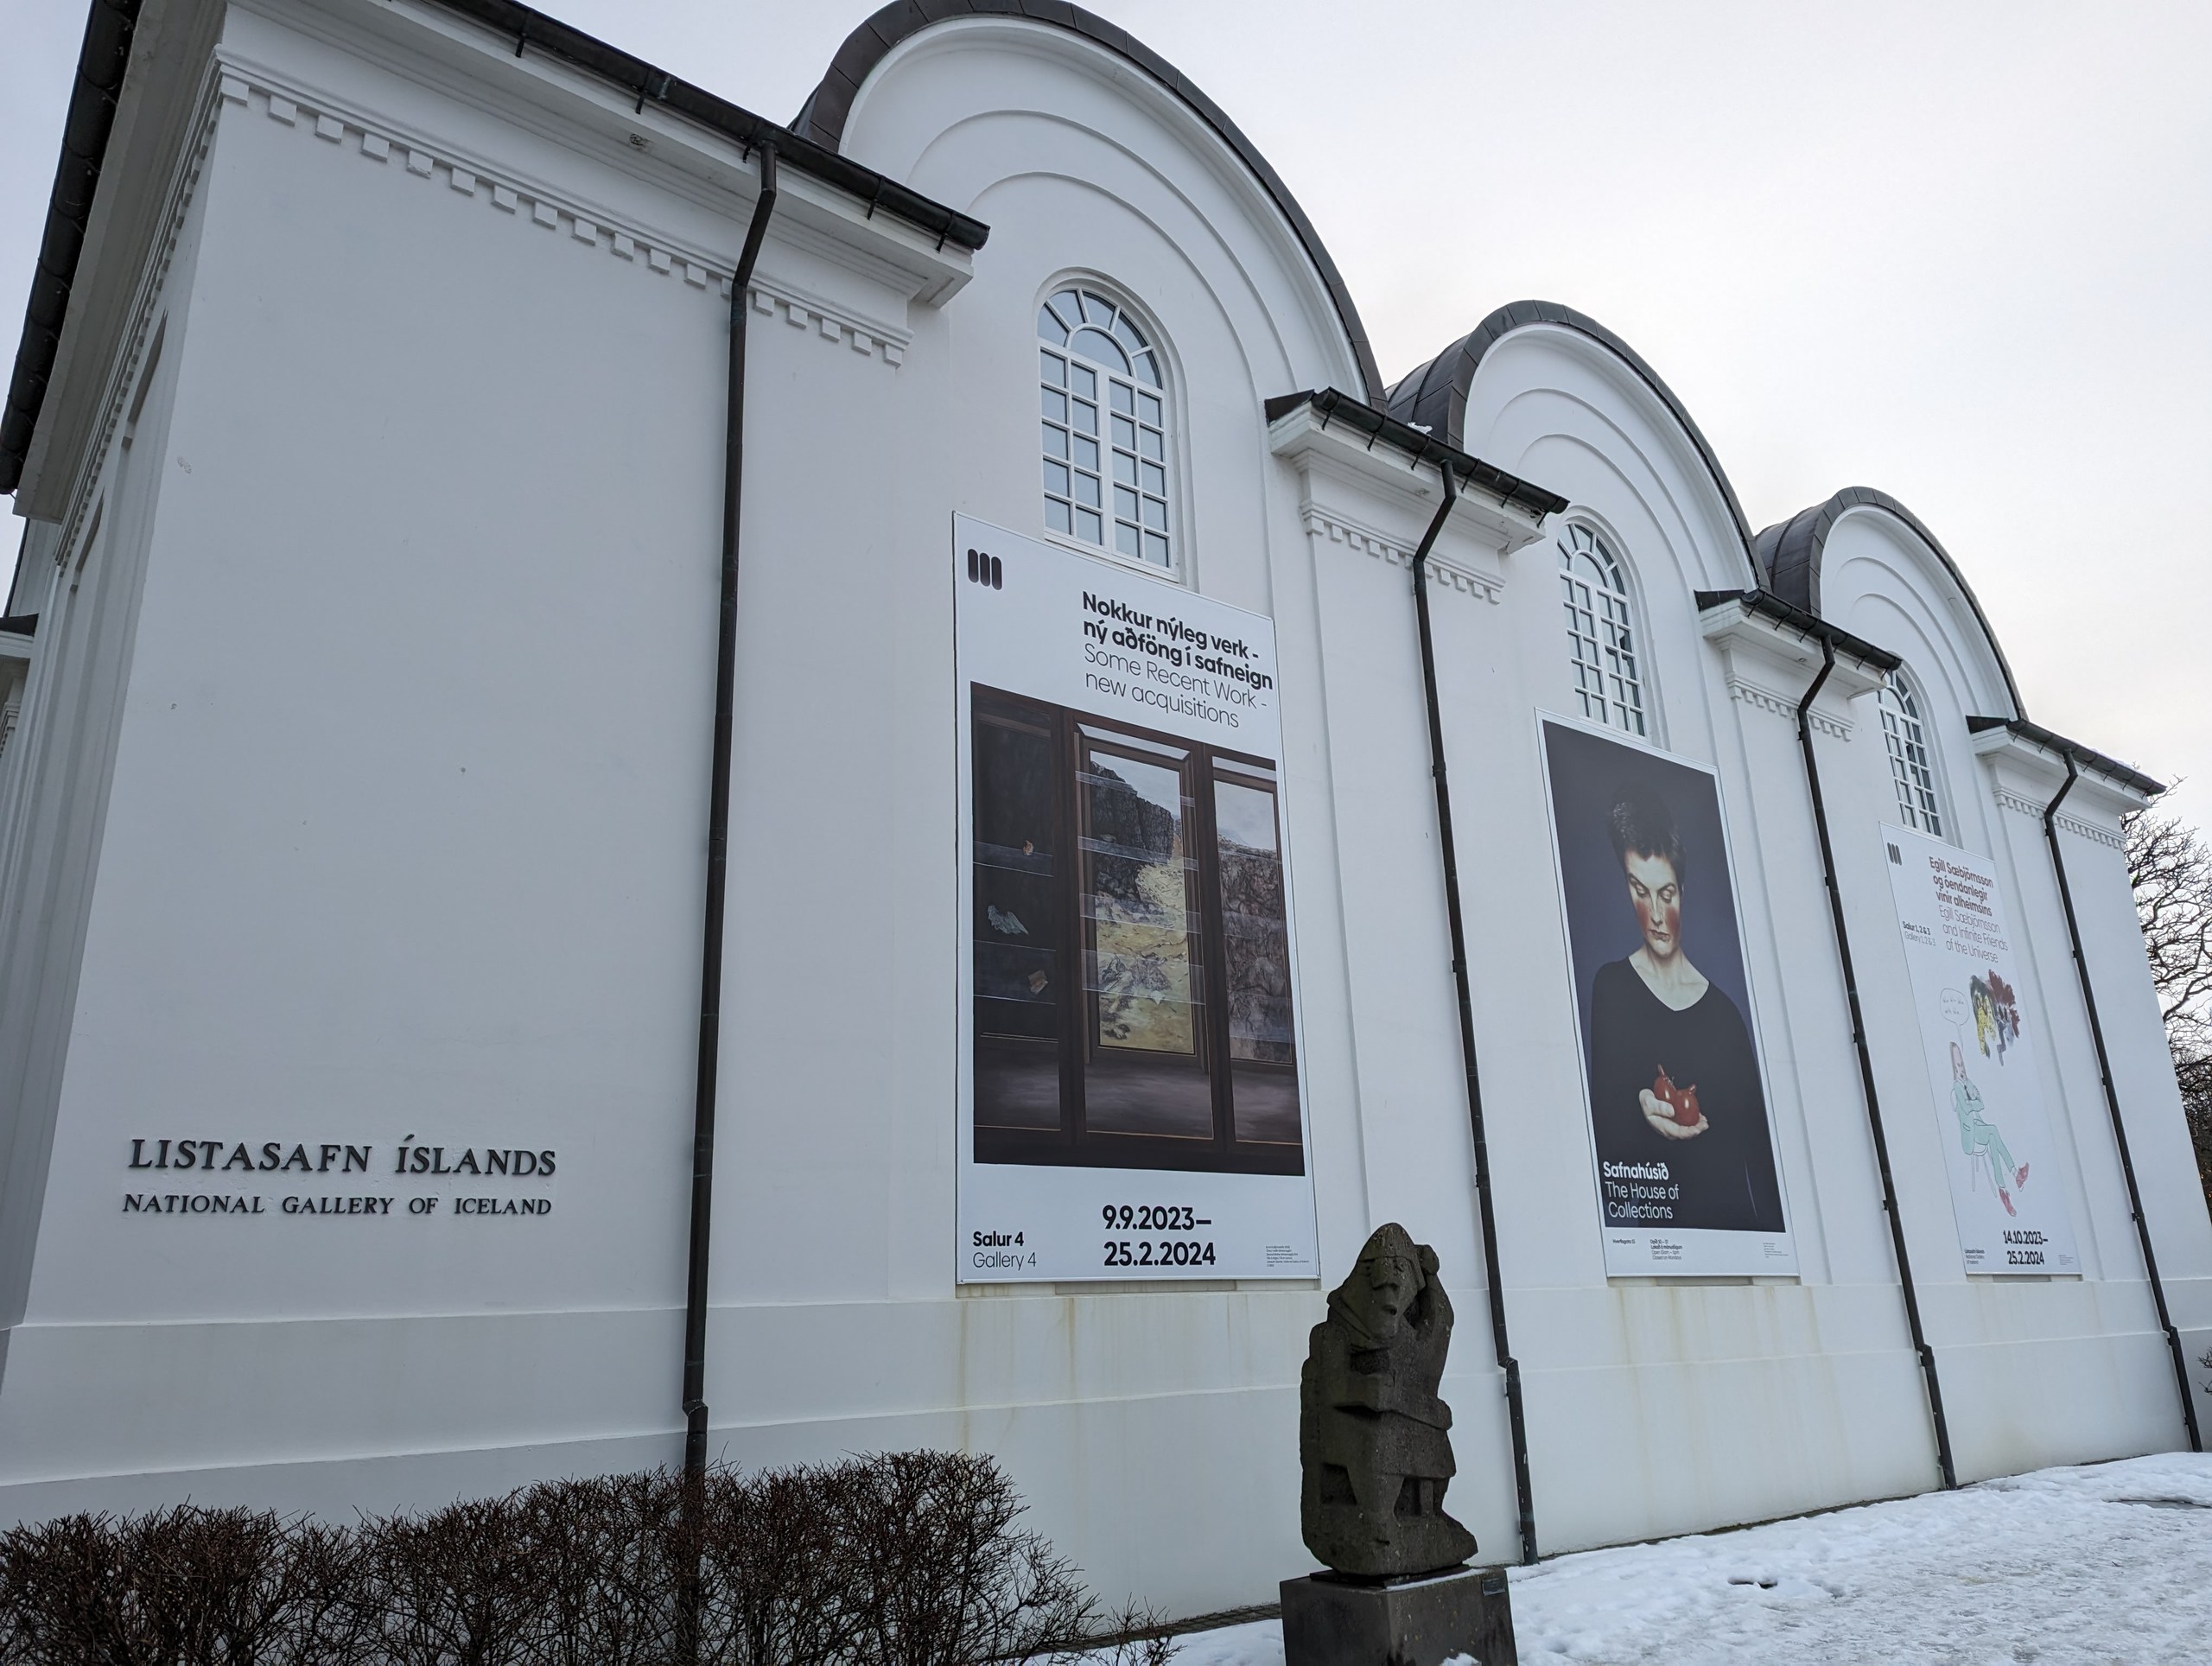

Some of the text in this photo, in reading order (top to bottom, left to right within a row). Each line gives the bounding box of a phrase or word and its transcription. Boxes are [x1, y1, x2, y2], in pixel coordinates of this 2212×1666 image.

[1082, 590, 1153, 630] Nokkur
[1156, 617, 1207, 650] nýleg
[1211, 635, 1249, 659] verk
[1083, 618, 1274, 691] ný aðföng í safneign
[1084, 643, 1141, 676] Some
[1147, 663, 1211, 696] Recent
[1213, 679, 1257, 709] Work
[1085, 671, 1240, 728] new acquisitions
[1929, 855, 1946, 874] Egill
[1933, 874, 1943, 889] og
[1936, 888, 1953, 905] vinir
[1942, 924, 1958, 937] and
[1982, 932, 2008, 951] Friends
[1946, 938, 1999, 963] of the Universe
[128, 1133, 556, 1176] LISTASAFN ÍSLANDS
[1603, 1160, 1669, 1180] Safnahúsið
[1605, 1181, 1680, 1199] The House of
[123, 1193, 552, 1215] NATIONAL GALLERY OF ICELAND
[1608, 1201, 1674, 1219] Collections
[972, 1230, 1025, 1248] Salur 4
[972, 1251, 1037, 1271] Gallery 4
[1103, 1240, 1217, 1267] 25.2.2024
[2006, 1250, 2045, 1265] 25.2.2024
